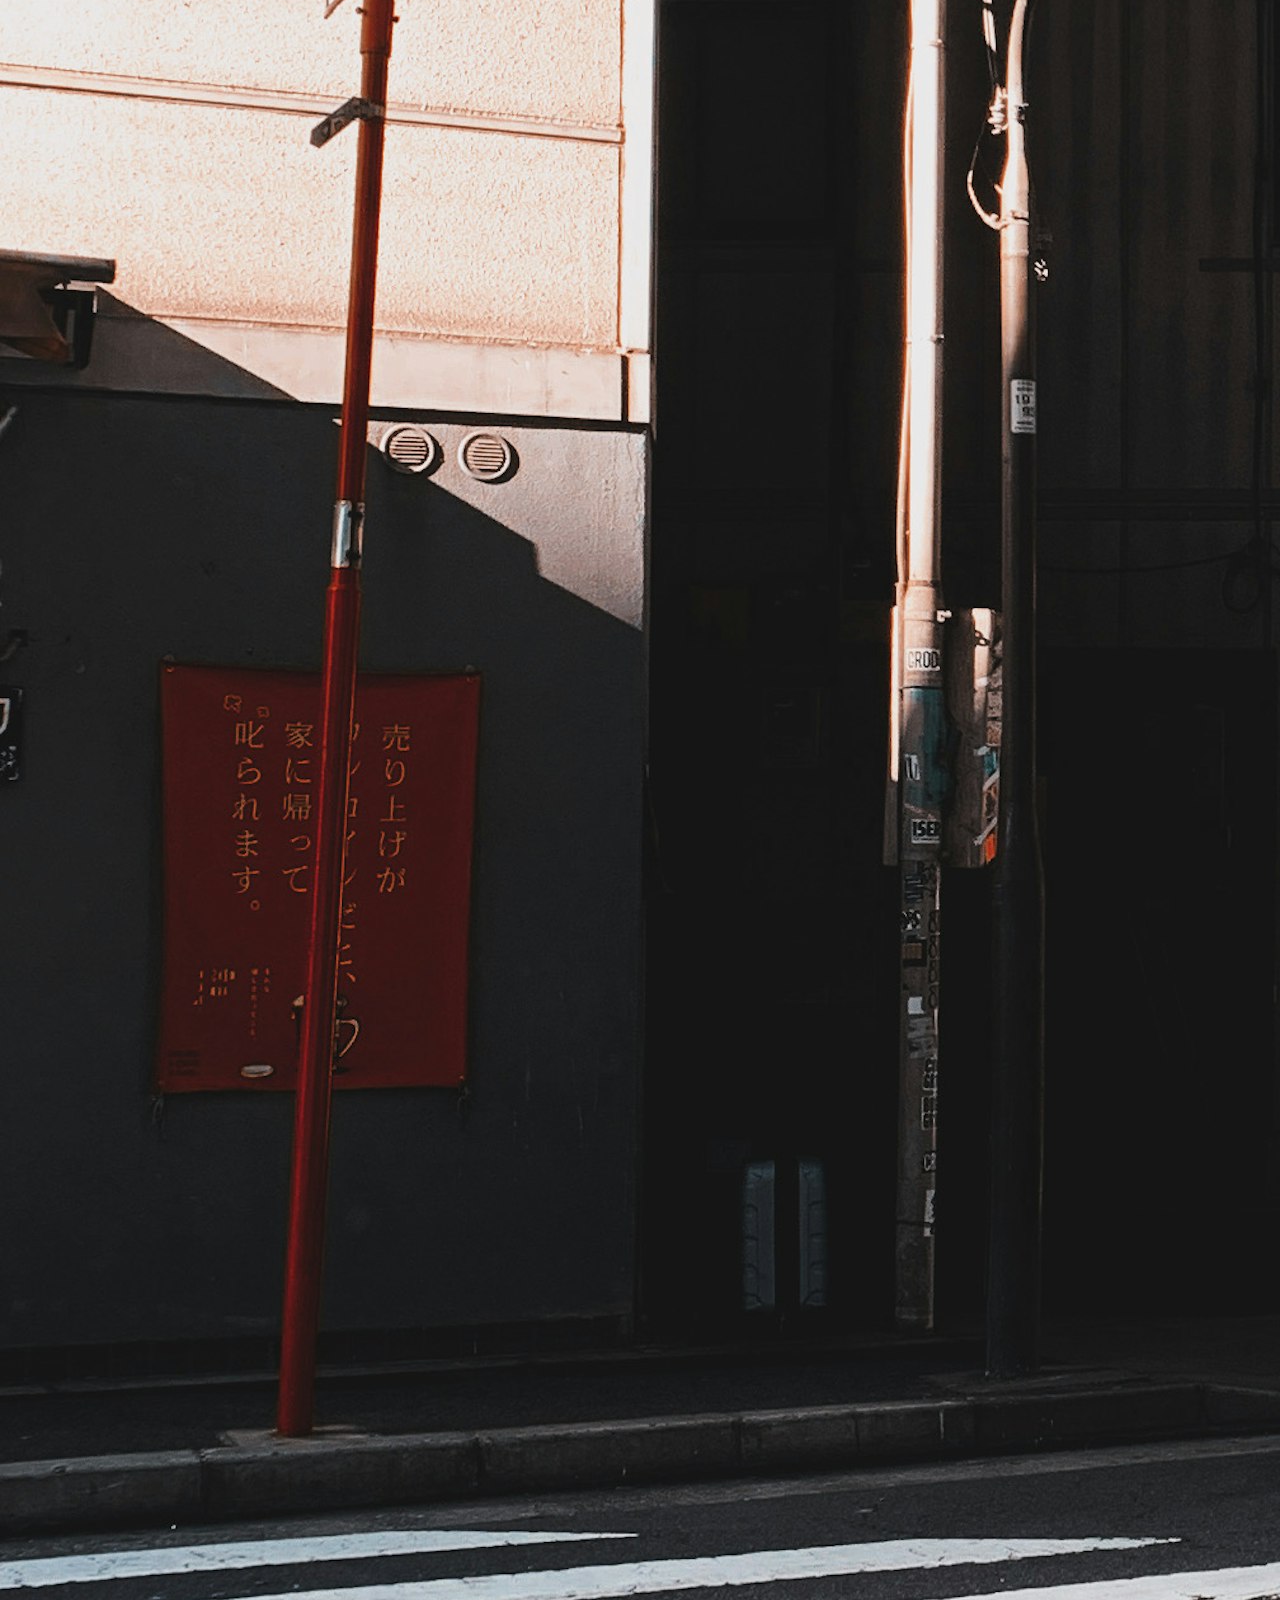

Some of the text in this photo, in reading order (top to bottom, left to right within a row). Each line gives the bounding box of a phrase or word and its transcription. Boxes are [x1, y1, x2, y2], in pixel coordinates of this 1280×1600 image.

[231, 721, 265, 912] 叱られます。
[281, 721, 314, 894] 家に帰って
[376, 722, 412, 894] 売り上げが
